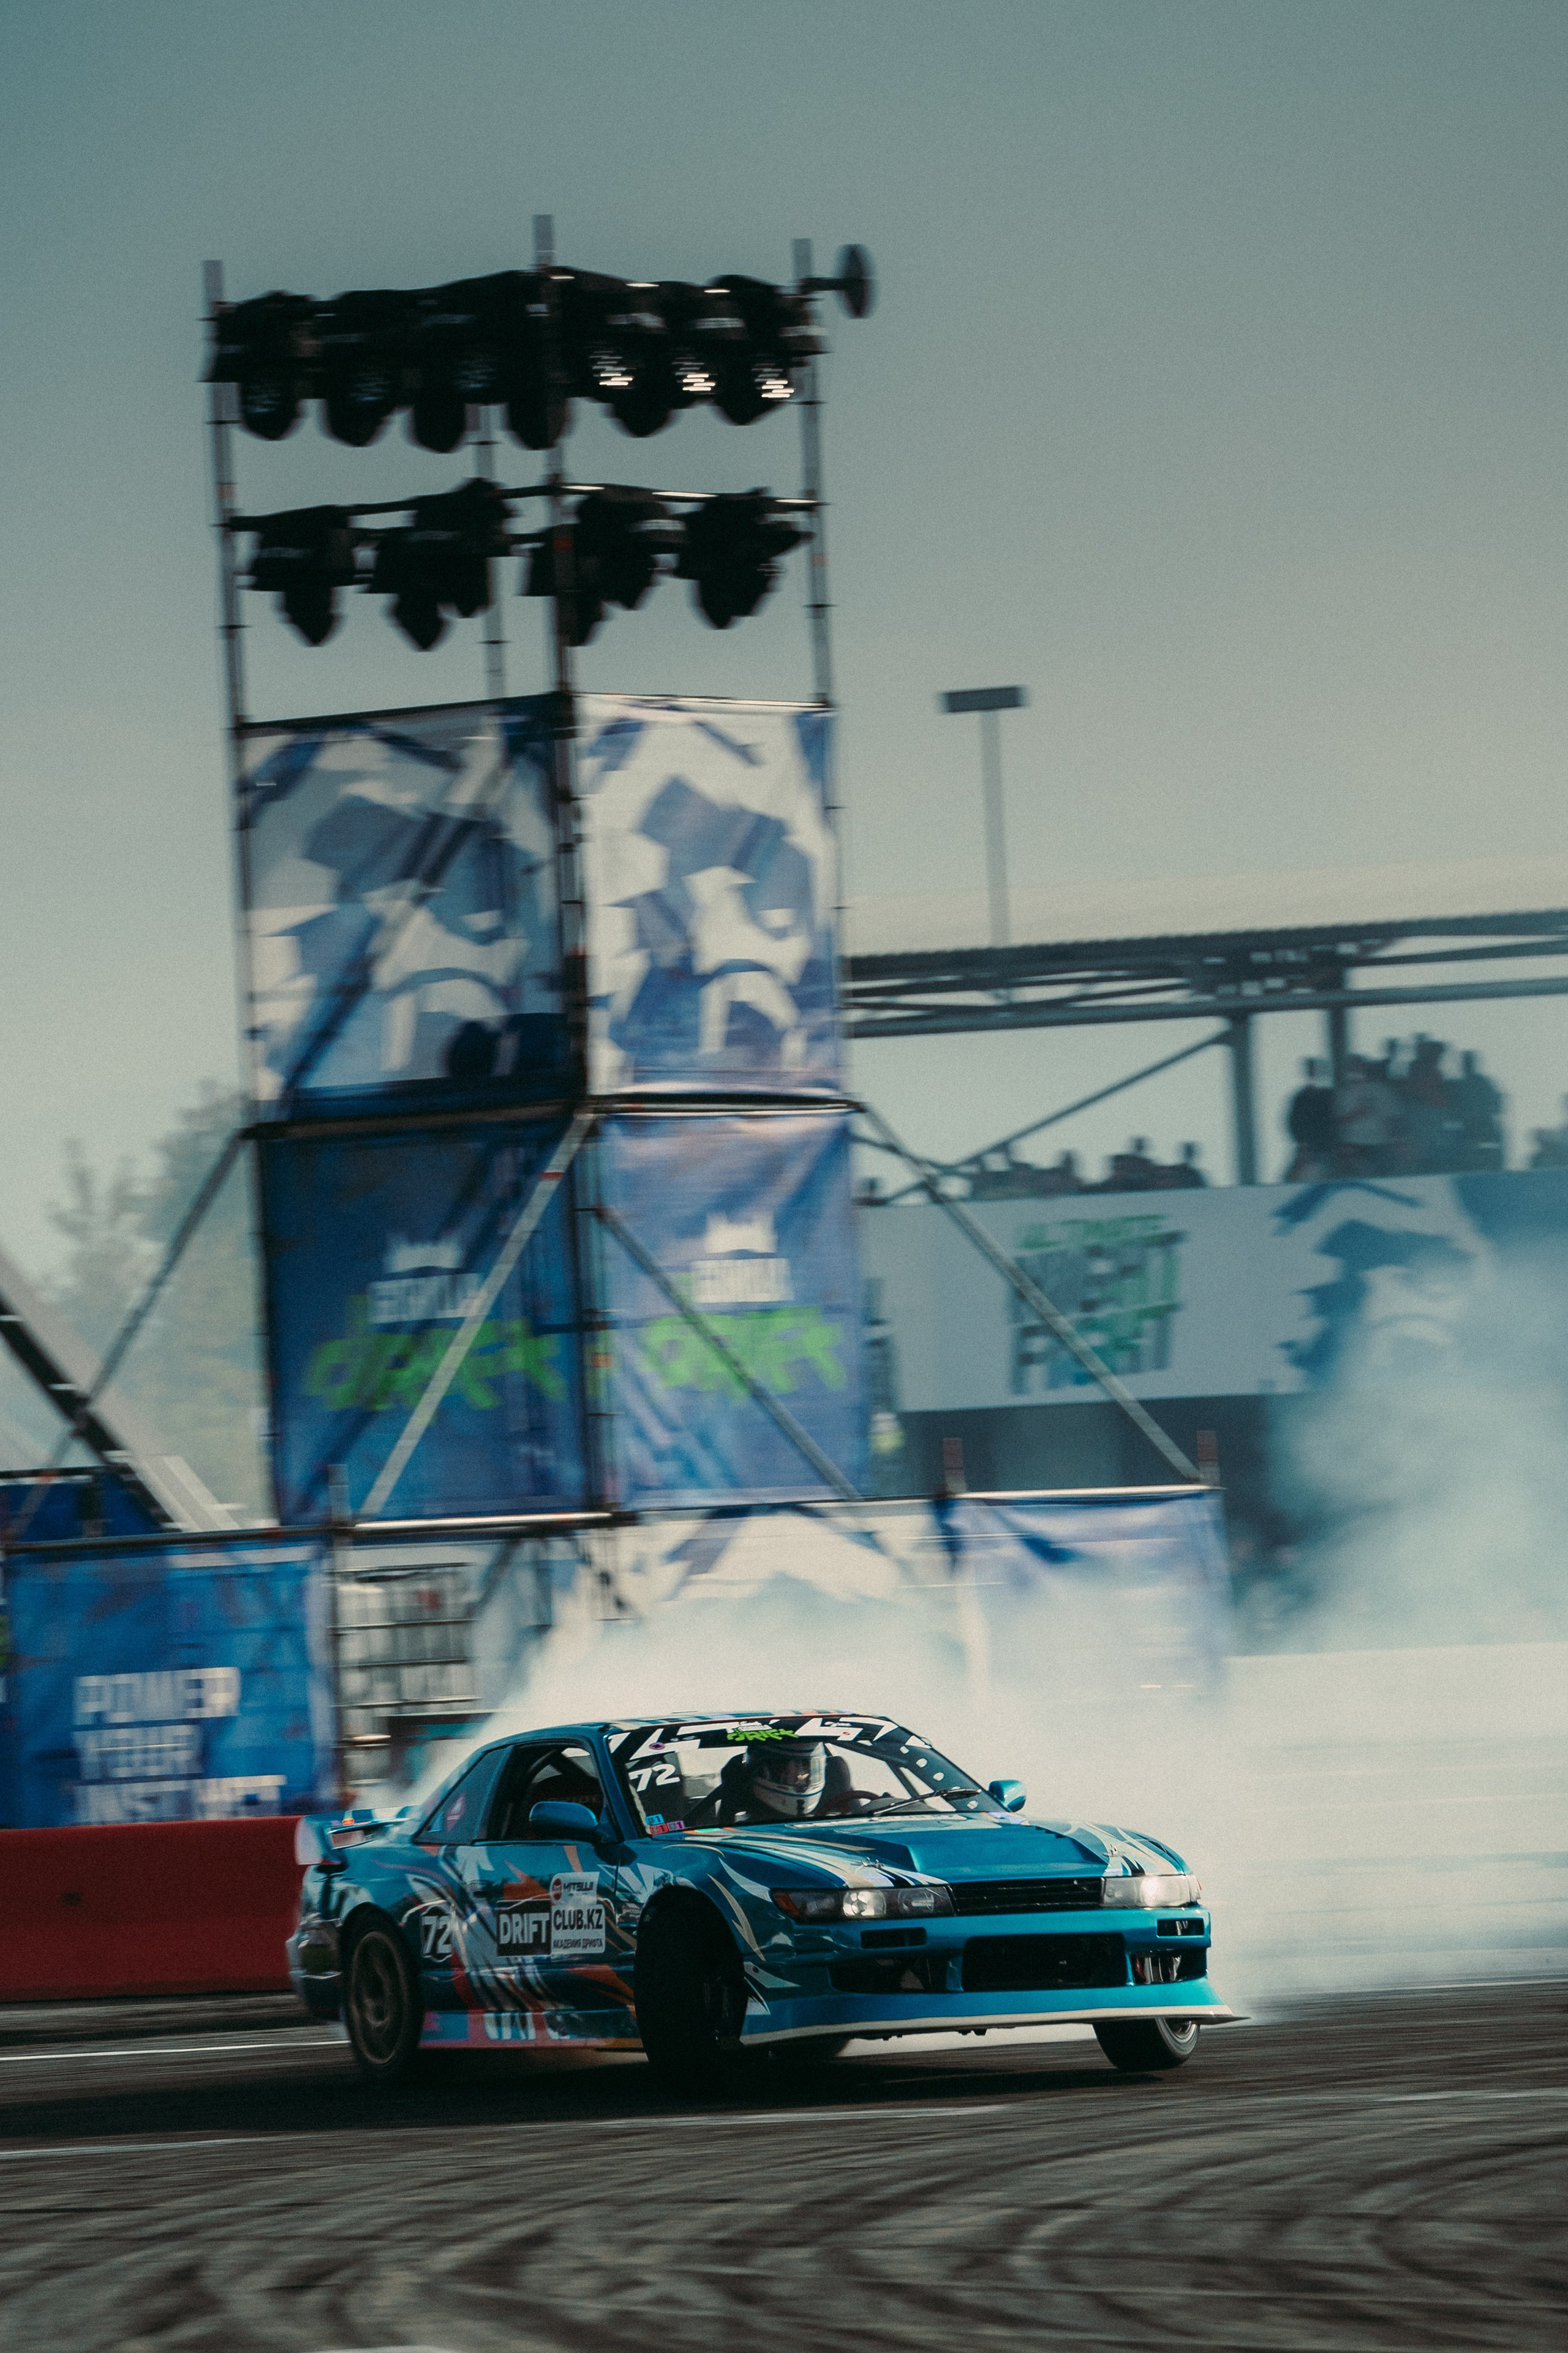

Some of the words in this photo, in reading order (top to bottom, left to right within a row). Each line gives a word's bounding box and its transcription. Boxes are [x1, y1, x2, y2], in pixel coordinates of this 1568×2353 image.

[628, 1763, 680, 1792] 72
[499, 1912, 551, 1944] DRIFT
[552, 1908, 604, 1931] CLUB.KZ
[421, 1916, 453, 1954] 72
